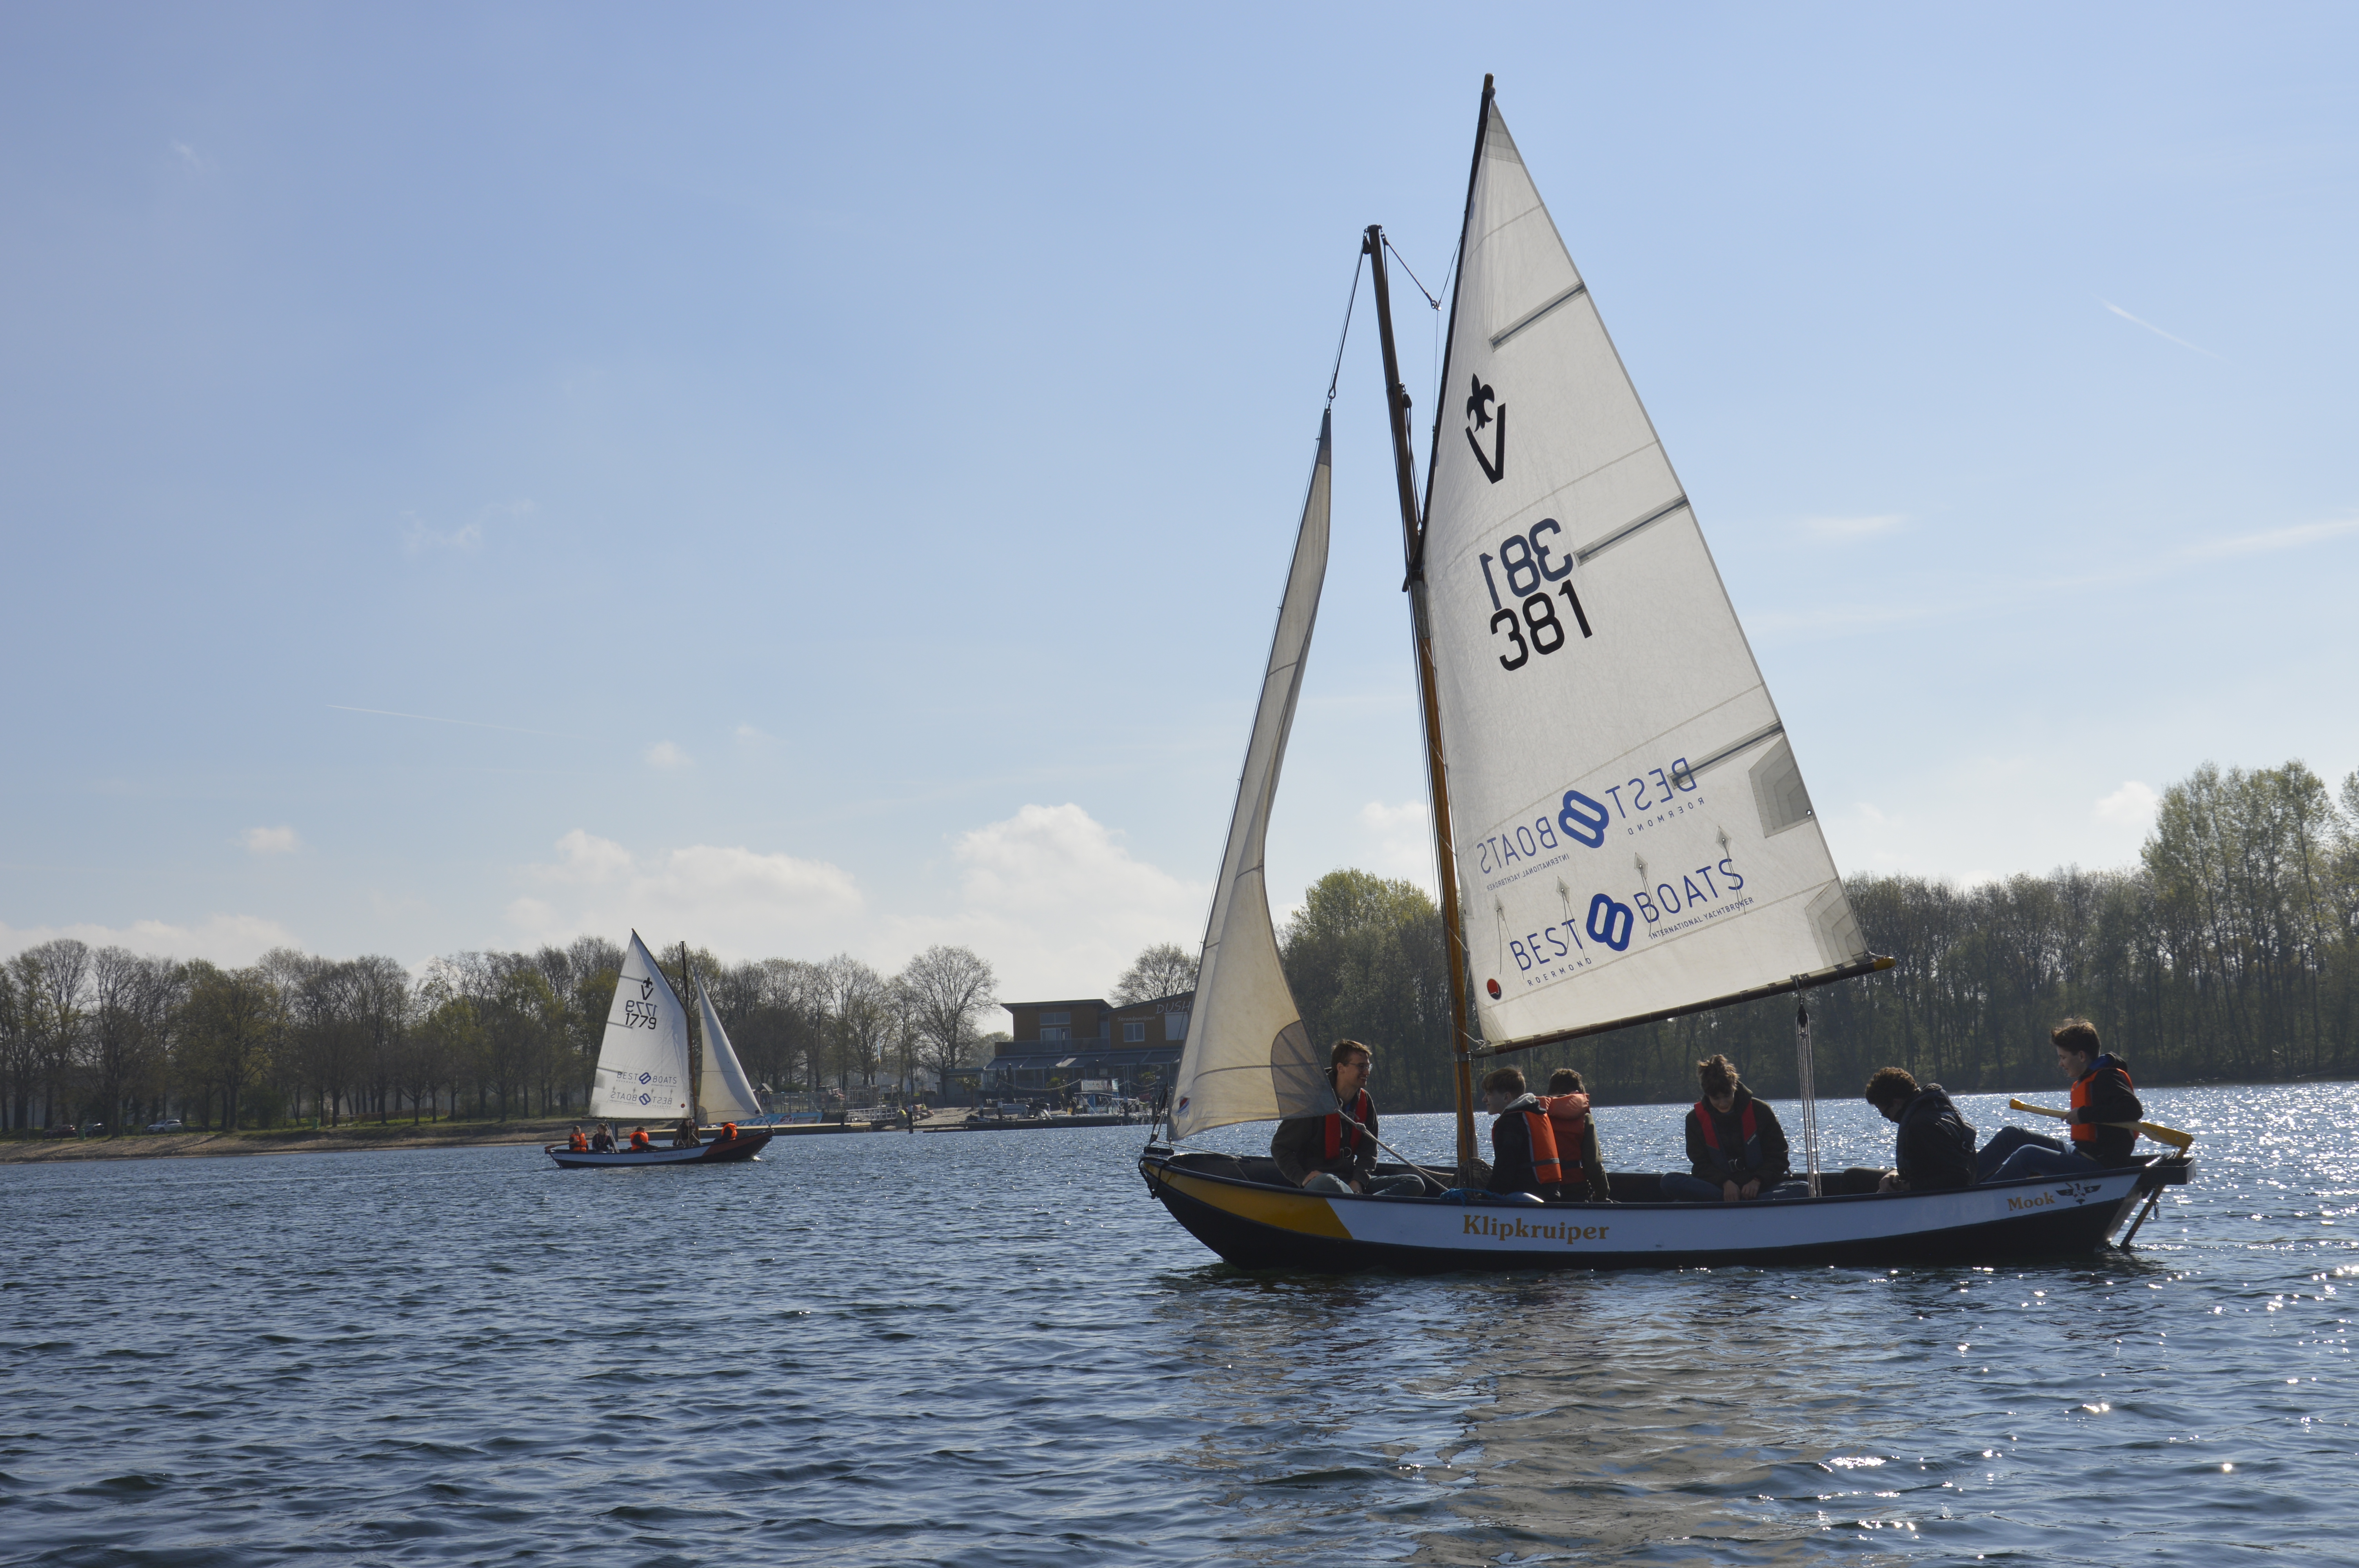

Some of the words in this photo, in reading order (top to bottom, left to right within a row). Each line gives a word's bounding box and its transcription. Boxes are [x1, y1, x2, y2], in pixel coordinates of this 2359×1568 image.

[1465, 403, 1506, 484] V
[1490, 579, 1593, 671] 381
[1510, 918, 1576, 971] BEST
[1634, 858, 1744, 923] BOATS
[1649, 916, 1703, 940] INTERNATIONAL
[1703, 897, 1754, 920] YACHTBROKER
[1527, 958, 1592, 986] ROERMOND
[641, 985, 654, 1000] V
[625, 1013, 657, 1030] 1779
[617, 1072, 638, 1080] BEST
[652, 1076, 677, 1084] BOATS
[2007, 1192, 2055, 1211] Mook
[1463, 1214, 1609, 1245] Klipkruiper
